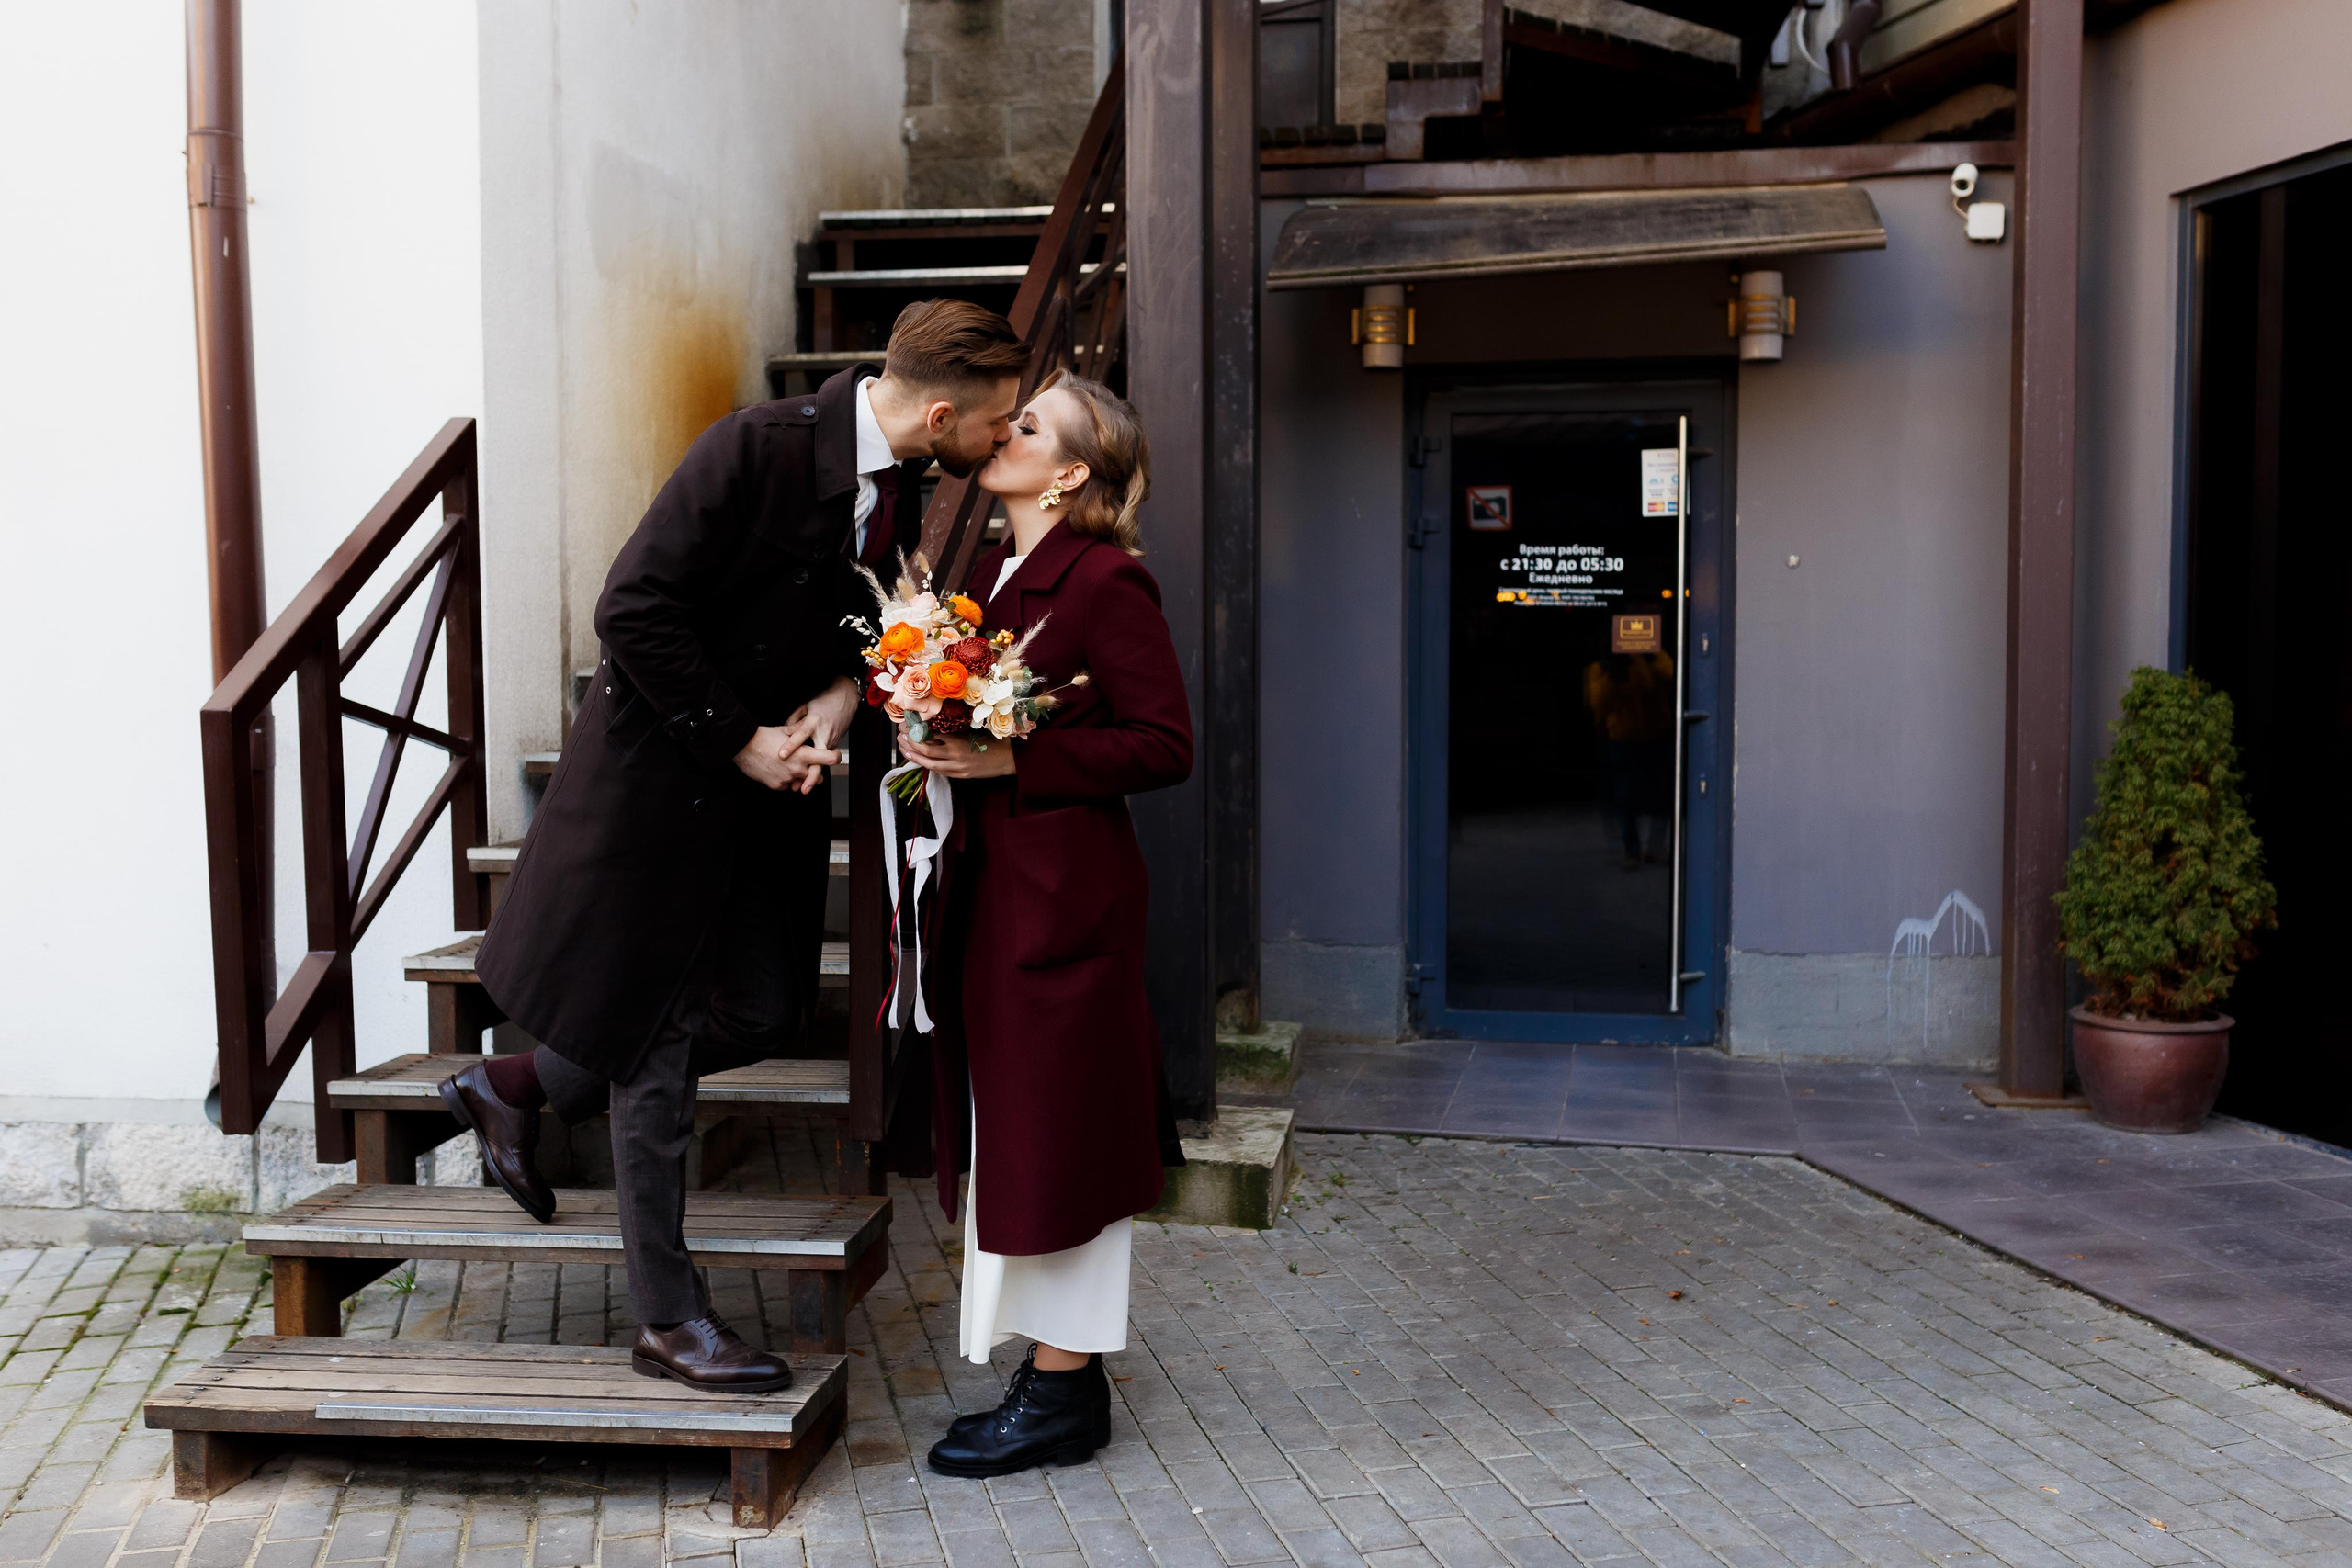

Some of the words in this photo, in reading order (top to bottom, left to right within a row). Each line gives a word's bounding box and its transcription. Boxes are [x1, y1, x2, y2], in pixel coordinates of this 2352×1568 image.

[1519, 543, 1556, 557] Время
[1558, 543, 1605, 558] работы:
[1500, 558, 1509, 570] с
[1511, 558, 1553, 571] 21:30
[1555, 559, 1577, 574] до
[1580, 557, 1624, 572] 05:30
[1529, 571, 1594, 585] Ежедневно
